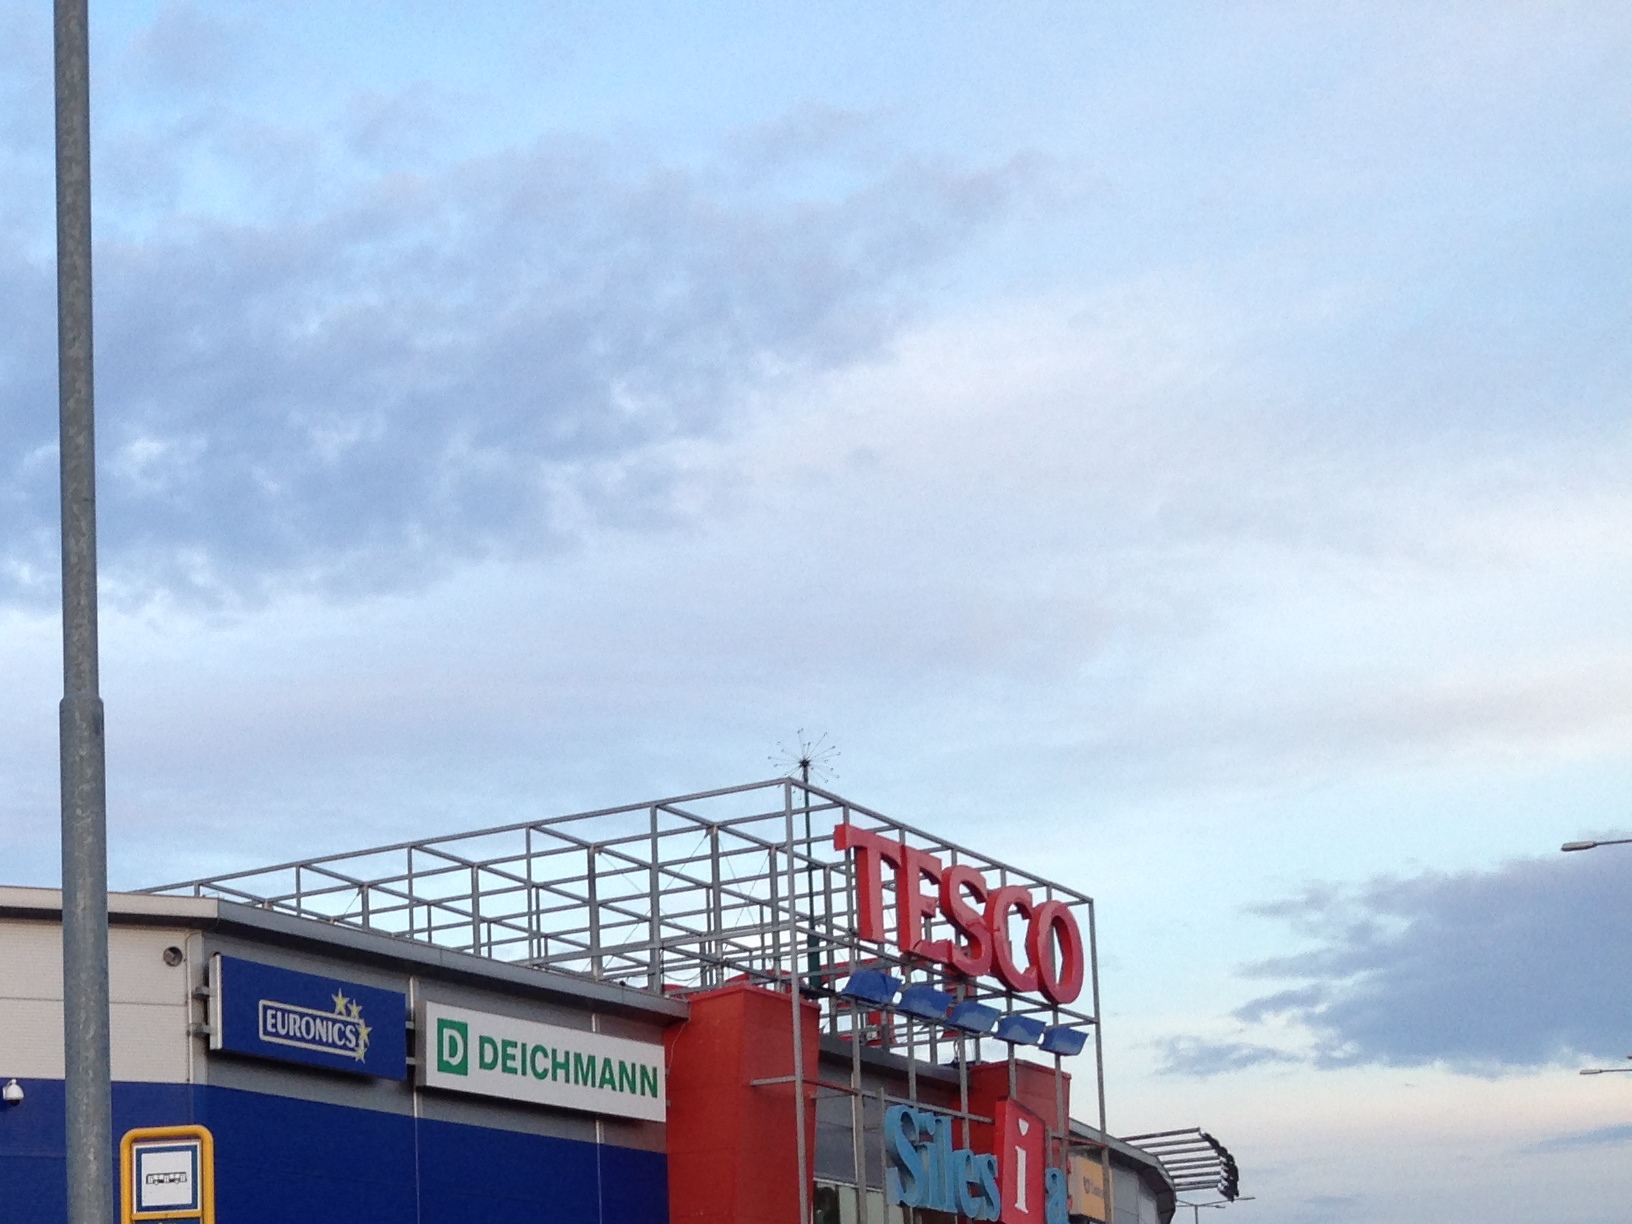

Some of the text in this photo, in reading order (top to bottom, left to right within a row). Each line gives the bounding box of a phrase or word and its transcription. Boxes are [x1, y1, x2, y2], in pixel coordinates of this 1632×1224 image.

[834, 824, 1084, 1004] TESCO
[266, 1008, 357, 1049] EURONICS
[479, 1035, 659, 1098] DEICHMANN
